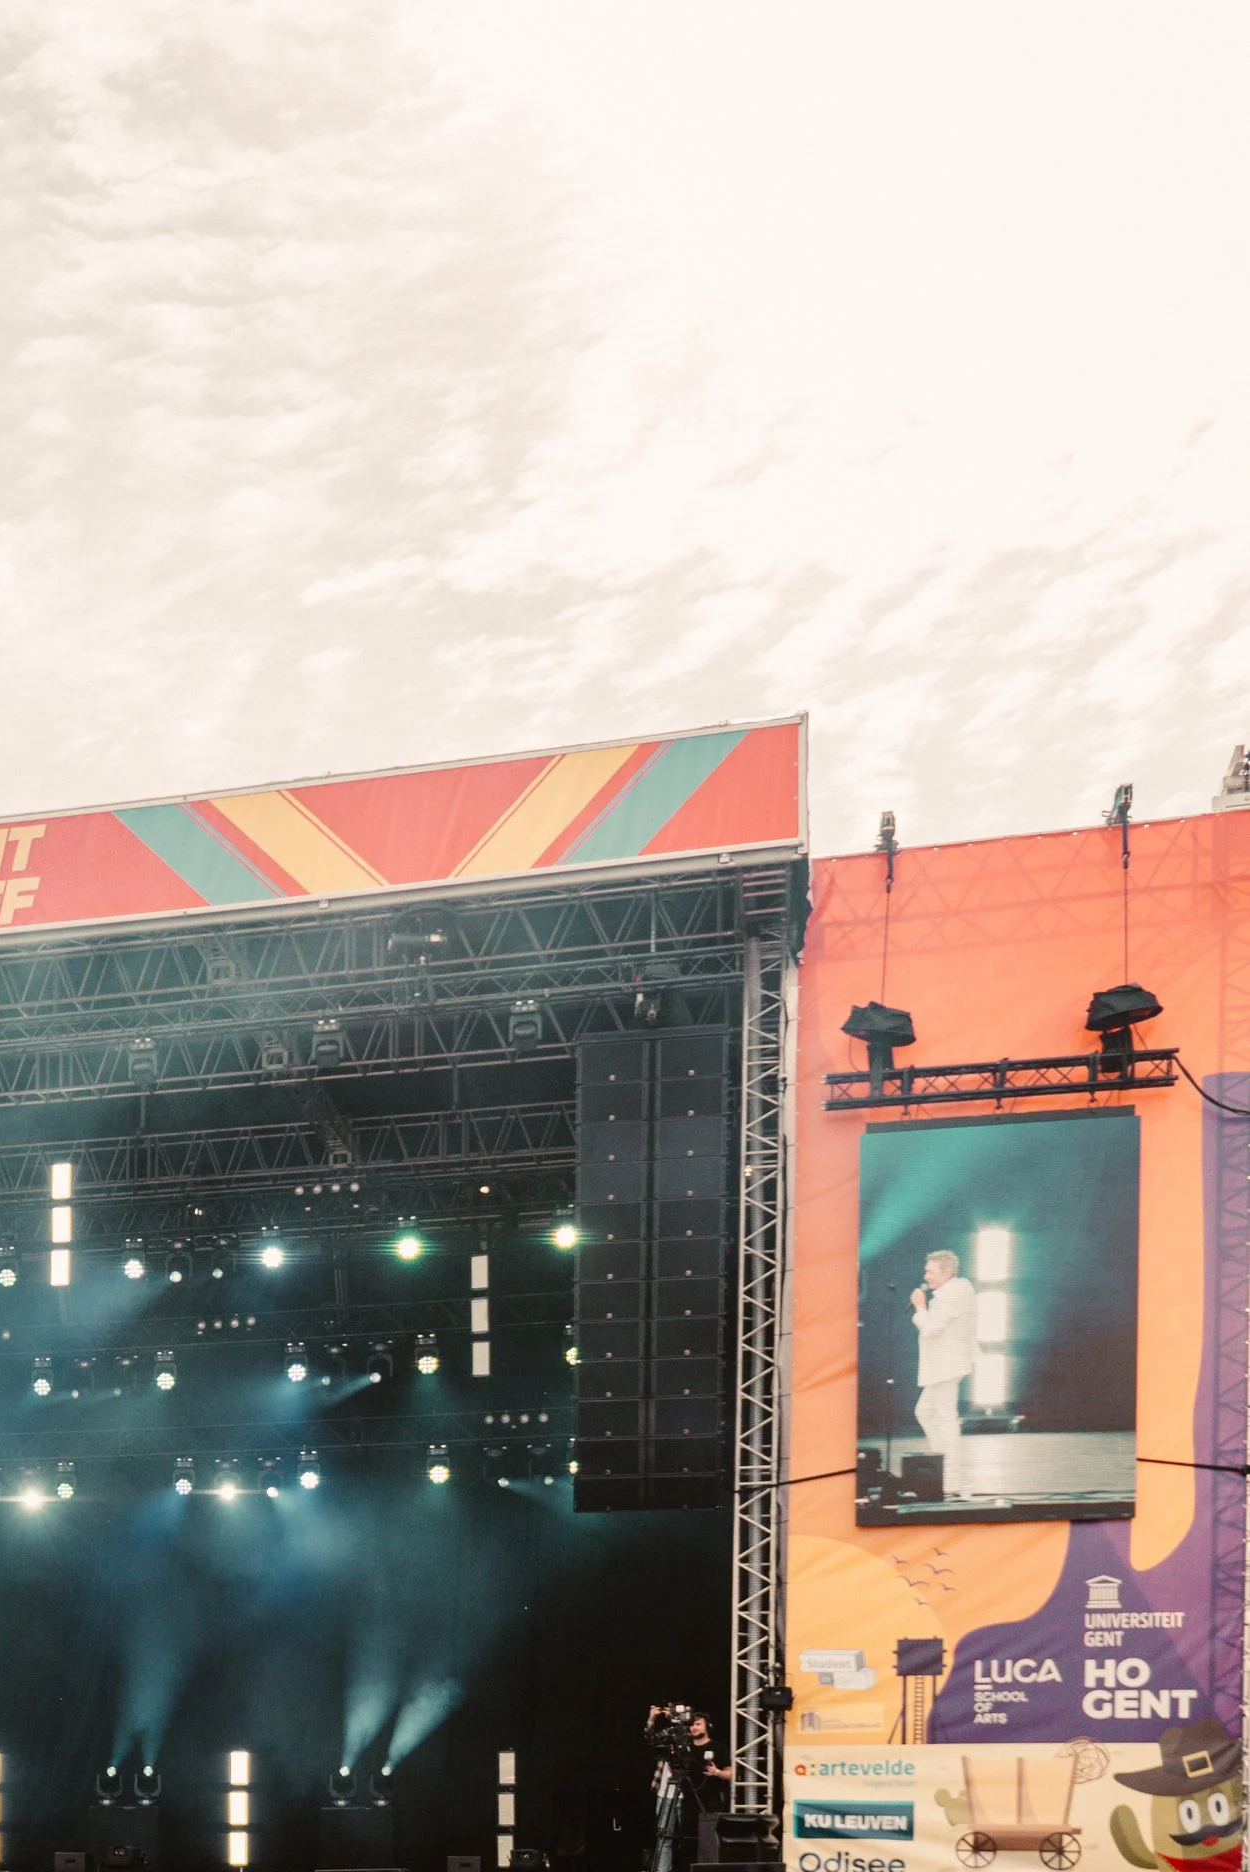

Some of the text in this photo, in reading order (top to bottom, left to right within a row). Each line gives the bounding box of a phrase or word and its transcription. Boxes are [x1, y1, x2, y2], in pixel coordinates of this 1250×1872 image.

[1085, 1611, 1186, 1629] UNIVERSITEIT
[1084, 1631, 1125, 1648] GENT
[974, 1658, 1063, 1684] LUCA
[1084, 1657, 1151, 1688] HO
[974, 1691, 1029, 1702] SCHOOL
[1082, 1689, 1198, 1720] GENT
[974, 1702, 994, 1713] OF
[973, 1713, 1008, 1724] ARTS
[804, 1813, 908, 1831] KU LEUVEN
